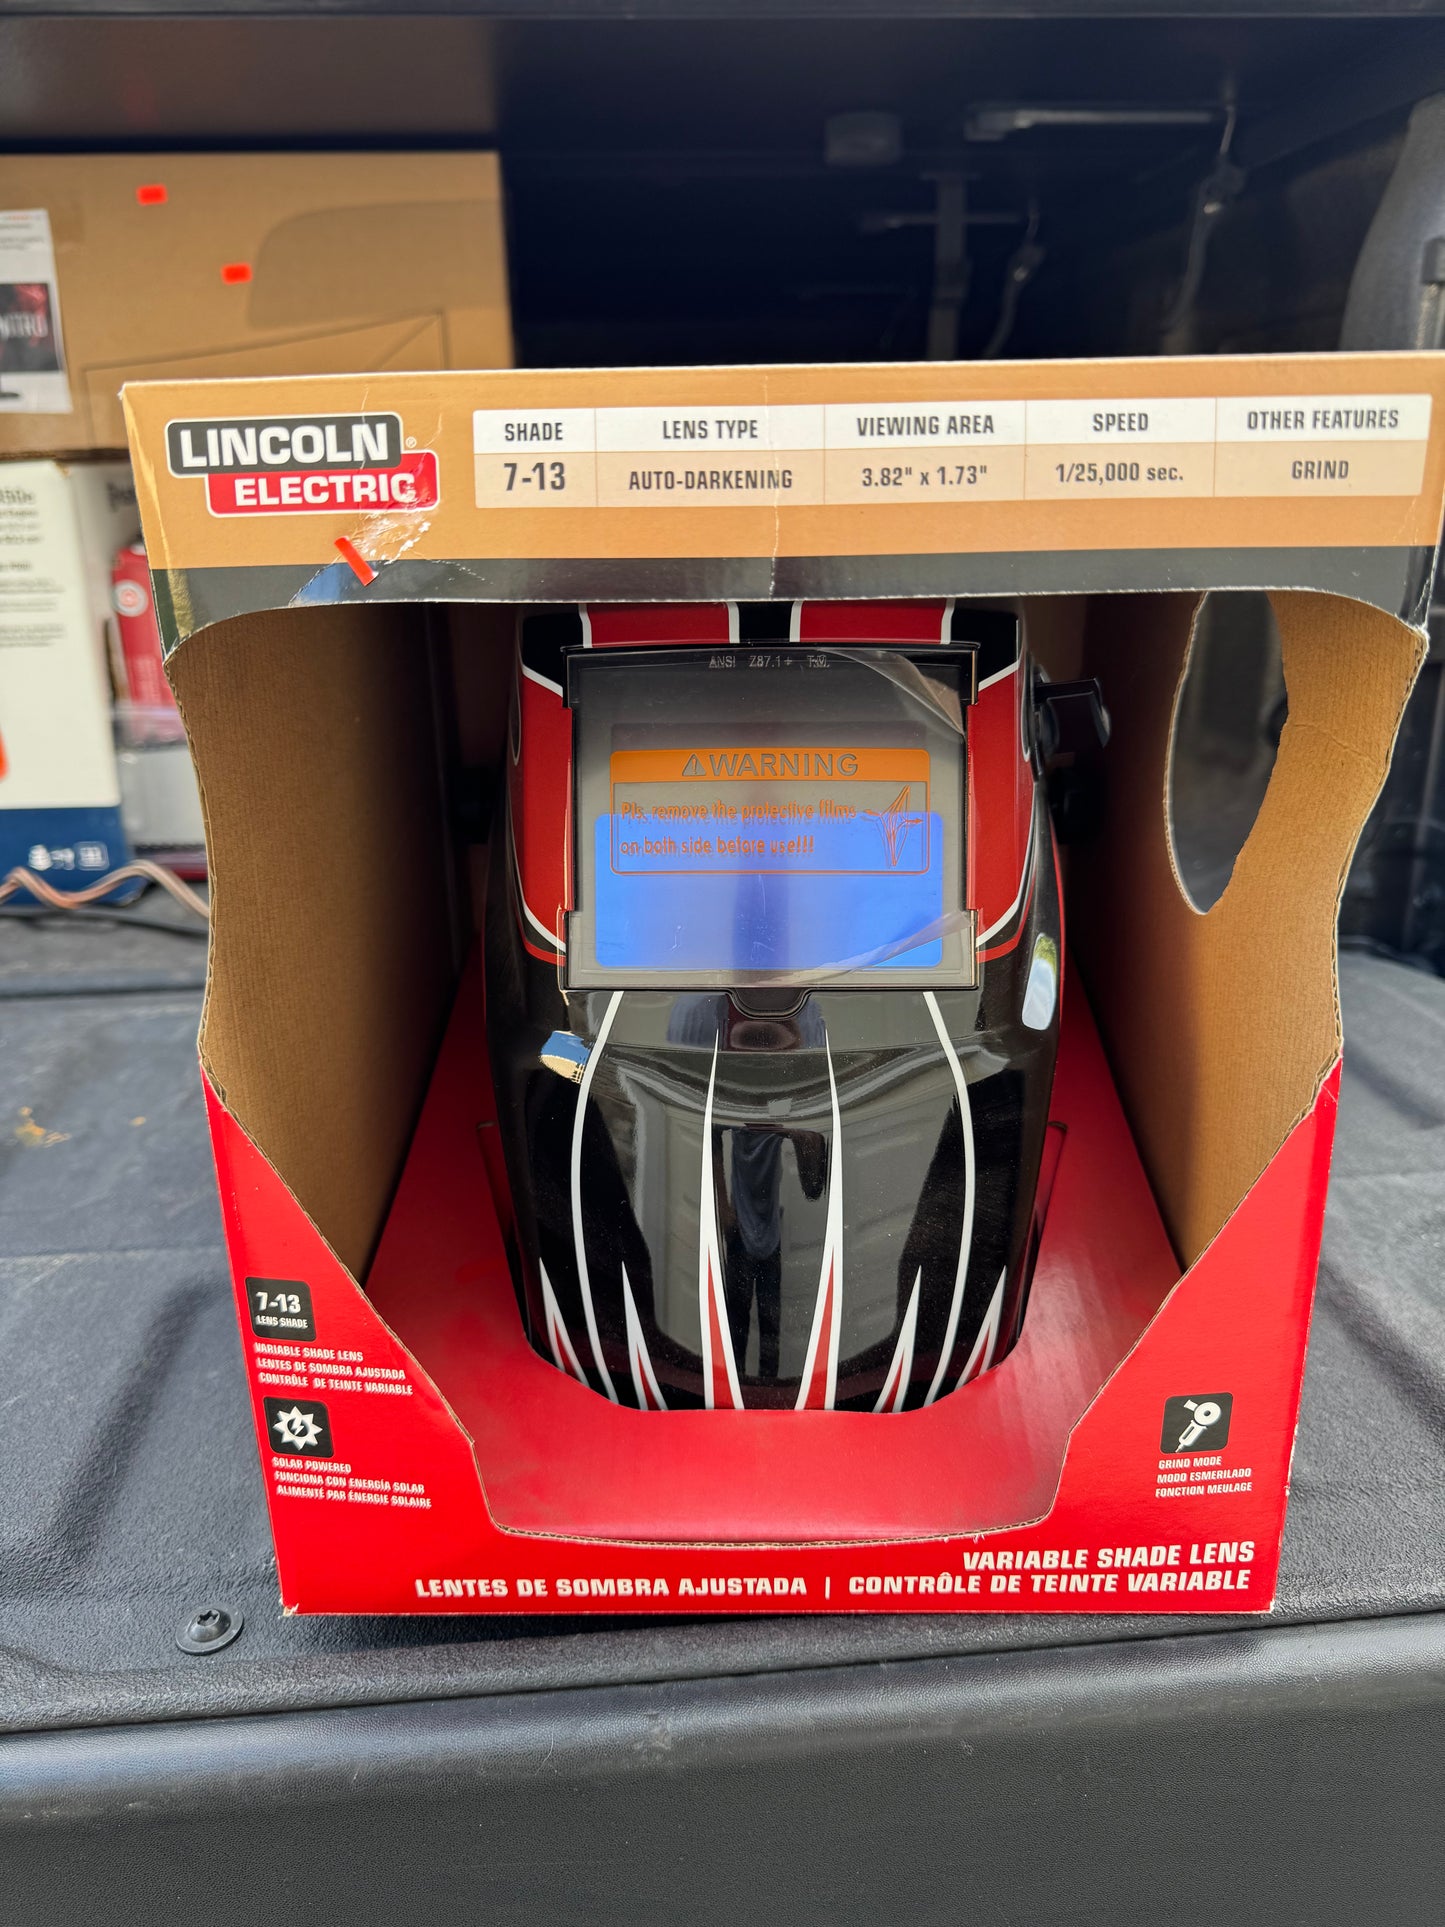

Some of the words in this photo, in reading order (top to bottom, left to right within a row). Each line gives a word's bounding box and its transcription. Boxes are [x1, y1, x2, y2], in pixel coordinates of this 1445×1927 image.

[663, 420, 708, 439] LENS
[716, 419, 758, 439] TYPE
[857, 416, 939, 436] VIEWING
[946, 414, 994, 435] AREA
[1092, 412, 1149, 432] SPEED
[1247, 410, 1305, 430] OTHER
[1312, 409, 1399, 429] FEATURES
[504, 422, 563, 441] SHADE
[180, 423, 388, 467] LINCOLN
[504, 461, 566, 491] 7-13
[628, 469, 792, 490] AUTO-DARKENING
[862, 466, 912, 487] 3.82"
[920, 472, 930, 486] x
[937, 465, 987, 486] 1.73"
[1055, 462, 1139, 486] 1/25,000
[1147, 465, 1184, 482] sec.
[1292, 460, 1349, 480] GRIND
[234, 472, 416, 506] ELECTRIC
[709, 753, 858, 777] WARNING
[652, 804, 708, 819] remove
[711, 800, 737, 819] the
[741, 801, 815, 822] protective
[819, 799, 857, 818] films
[620, 841, 639, 854] on
[644, 836, 677, 854] both
[681, 836, 711, 854] side
[717, 835, 765, 854] before
[770, 835, 814, 853] use!!!
[255, 1291, 301, 1314] 7-13
[256, 1315, 279, 1327] LENS
[279, 1317, 308, 1329] SHADE
[254, 1342, 301, 1357] VARIABLE
[302, 1347, 336, 1360] SHADE
[337, 1350, 364, 1362] LENS
[256, 1357, 292, 1371] LENTES
[293, 1360, 307, 1372] DE
[309, 1361, 353, 1376] SOMBRA
[355, 1366, 406, 1381] AJUSTADA
[258, 1372, 308, 1387] CONTRÔLE
[313, 1377, 327, 1389] DE
[328, 1378, 363, 1392] TEINTE
[365, 1381, 413, 1396] VARIABLE
[272, 1457, 303, 1470] SOLAR
[305, 1459, 352, 1475] POWERED
[1158, 1458, 1190, 1470] GRIND
[1193, 1455, 1222, 1467] MODE
[274, 1471, 324, 1486] FUNCIONA
[325, 1475, 347, 1488] CON
[348, 1476, 391, 1492] ENERGÍA
[393, 1481, 425, 1496] SOLAR
[1156, 1472, 1187, 1484] MODO
[1189, 1468, 1252, 1482] ESMERILADO
[276, 1484, 325, 1500] ALIMENTÉ
[326, 1488, 346, 1502] PAR
[391, 1494, 432, 1510] SOLAIRE
[1155, 1485, 1205, 1499] FONCTION
[1207, 1482, 1253, 1495] MEULAGE
[963, 1550, 1088, 1571] VARIABLE
[1097, 1545, 1180, 1568] SHADE
[1189, 1541, 1255, 1565] LENS
[415, 1578, 509, 1597] LENTES
[517, 1578, 549, 1597] DE
[556, 1577, 670, 1597] SOMBRA
[678, 1576, 808, 1597] AJUSTADA
[848, 1572, 981, 1595] CONTRÔLE
[990, 1575, 1022, 1594] DE
[1028, 1573, 1118, 1594] TEINTE
[1127, 1570, 1250, 1592] VARIABLE
